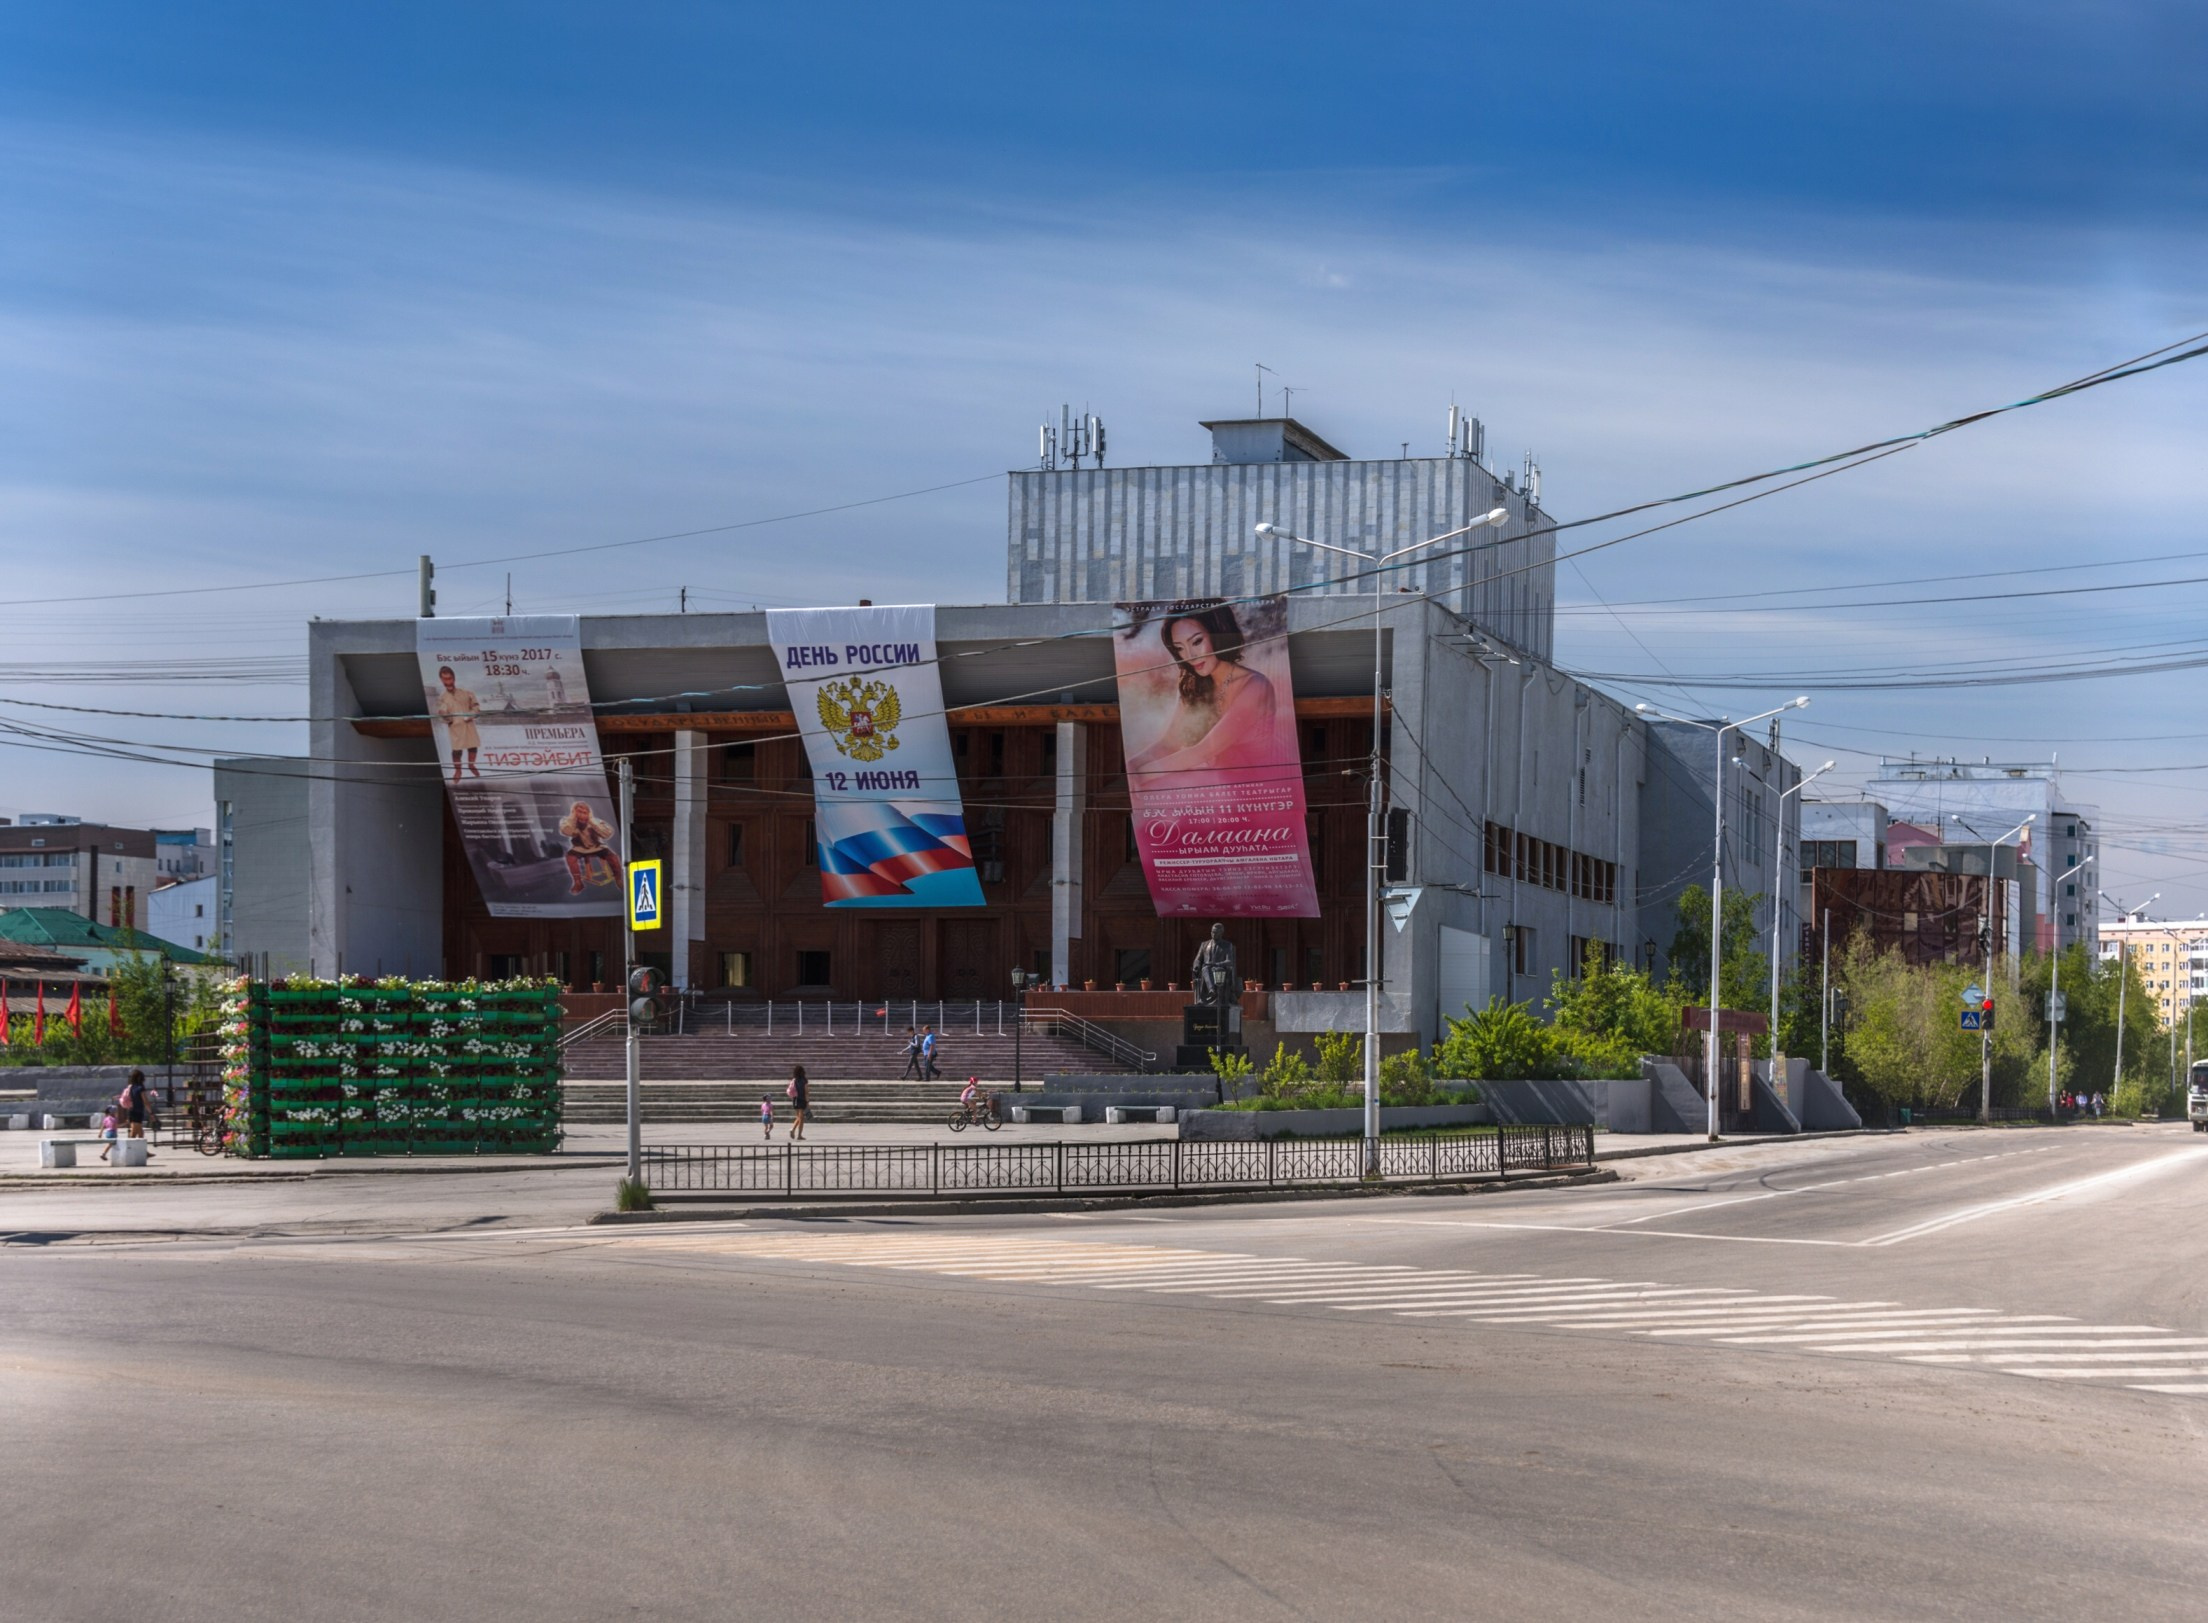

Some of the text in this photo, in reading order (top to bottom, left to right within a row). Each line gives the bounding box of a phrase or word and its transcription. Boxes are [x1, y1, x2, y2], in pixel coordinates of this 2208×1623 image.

[436, 654, 453, 662] Бэс
[454, 653, 480, 662] ыйын
[482, 650, 498, 662] 15
[521, 648, 552, 661] 2017
[786, 643, 921, 669] ДЕНЬ РОССИИ
[486, 665, 520, 676] 18:30
[525, 727, 586, 740] ПРЕМЬЕРА
[483, 748, 592, 767] ТИЭТЭЙБИТ
[825, 770, 921, 792] 12 ИЮНЯ
[1241, 786, 1292, 795] ТЕАТРЫГАР
[1171, 804, 1215, 817] ЫЙЫН
[1220, 804, 1233, 814] 11
[1237, 801, 1294, 813] КҮНҮГЭР
[1188, 817, 1210, 825] 17:00
[1218, 816, 1240, 824] 20:00
[1145, 819, 1293, 846] Далаана
[1178, 846, 1219, 855] ЫРЫАМ
